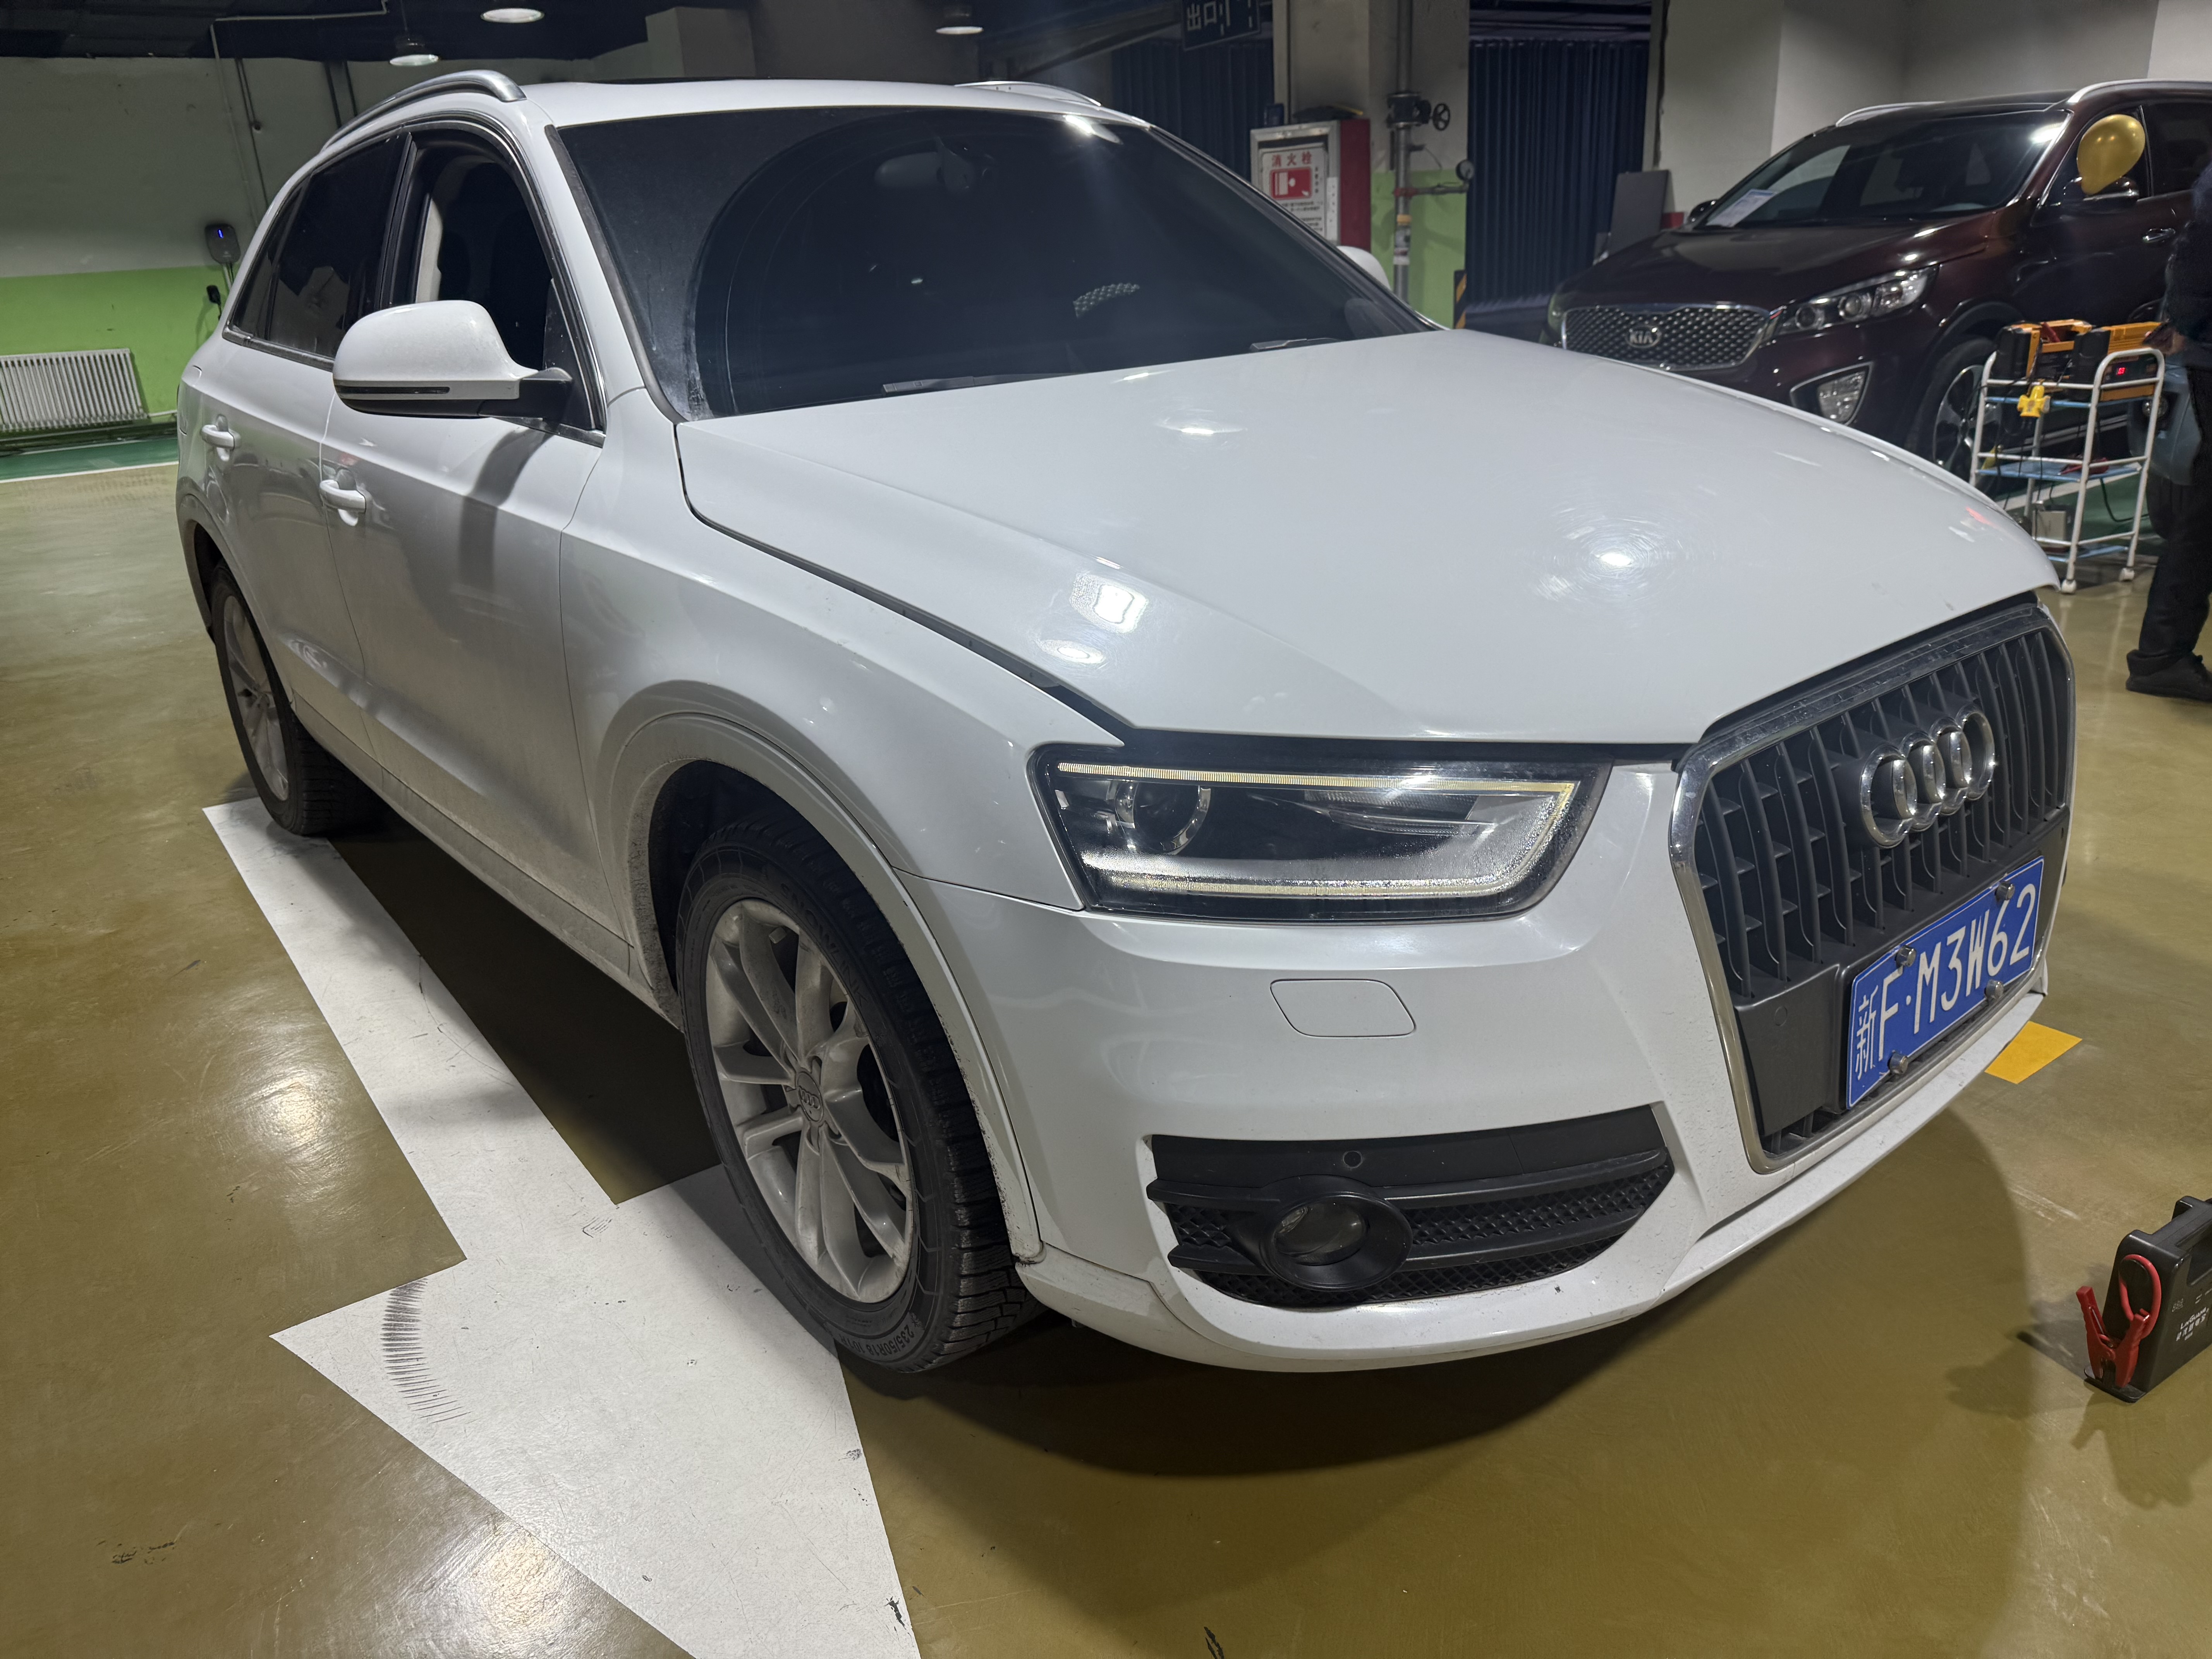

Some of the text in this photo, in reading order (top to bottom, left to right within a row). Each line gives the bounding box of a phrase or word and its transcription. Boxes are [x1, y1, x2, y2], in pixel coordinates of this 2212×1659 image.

[1187, 0, 1217, 31] 出口
[1272, 151, 1312, 167] 消火栓
[1630, 330, 1653, 344] KIA
[1855, 883, 2037, 1081] 新F·M3W62
